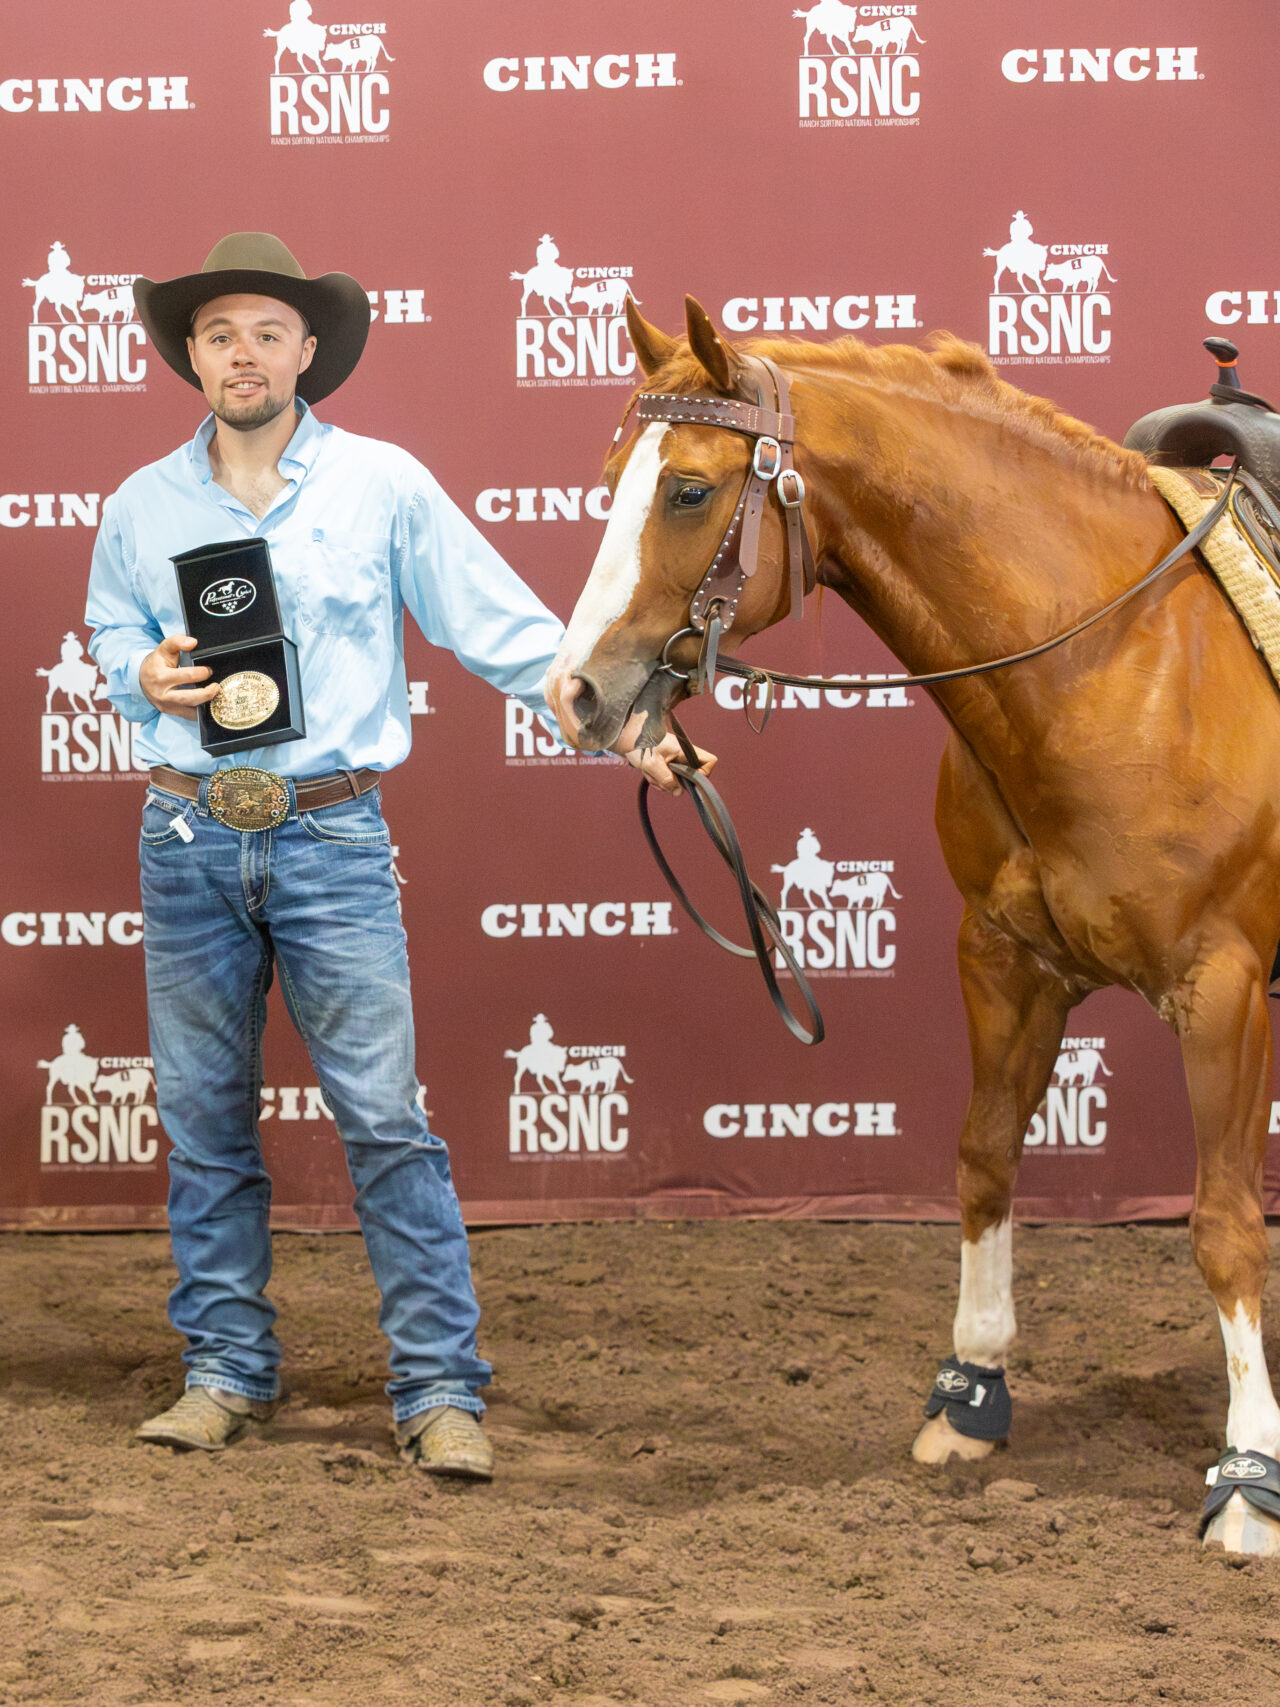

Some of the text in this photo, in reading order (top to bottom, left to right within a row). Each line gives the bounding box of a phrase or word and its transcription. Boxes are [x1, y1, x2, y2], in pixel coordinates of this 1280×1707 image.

[329, 23, 387, 35] CINCH
[860, 5, 918, 16] CINCH
[483, 52, 677, 92] CINCH
[1000, 46, 1198, 83] CINCH
[270, 73, 390, 136] RSNC
[798, 55, 920, 118] RSNC
[845, 118, 872, 127] NATIONAL
[1050, 244, 1108, 255] CINCH
[576, 267, 633, 278] CINCH
[721, 294, 917, 332] CINCH
[989, 293, 1111, 355] RSNC
[28, 323, 147, 384] RSNC
[516, 316, 637, 378] RSNC
[474, 485, 614, 523] CINC
[505, 698, 575, 757] RS
[232, 770, 261, 780] OPEN
[836, 861, 894, 872] CINCH
[0, 911, 144, 947] CINC
[480, 901, 673, 938] CINCH
[776, 909, 896, 969] RSNC
[569, 1045, 626, 1056] CINCH
[1061, 1037, 1106, 1049] INCH
[40, 1105, 158, 1163] RSNC
[509, 1093, 629, 1153] RSNC
[703, 1102, 897, 1139] CINCH
